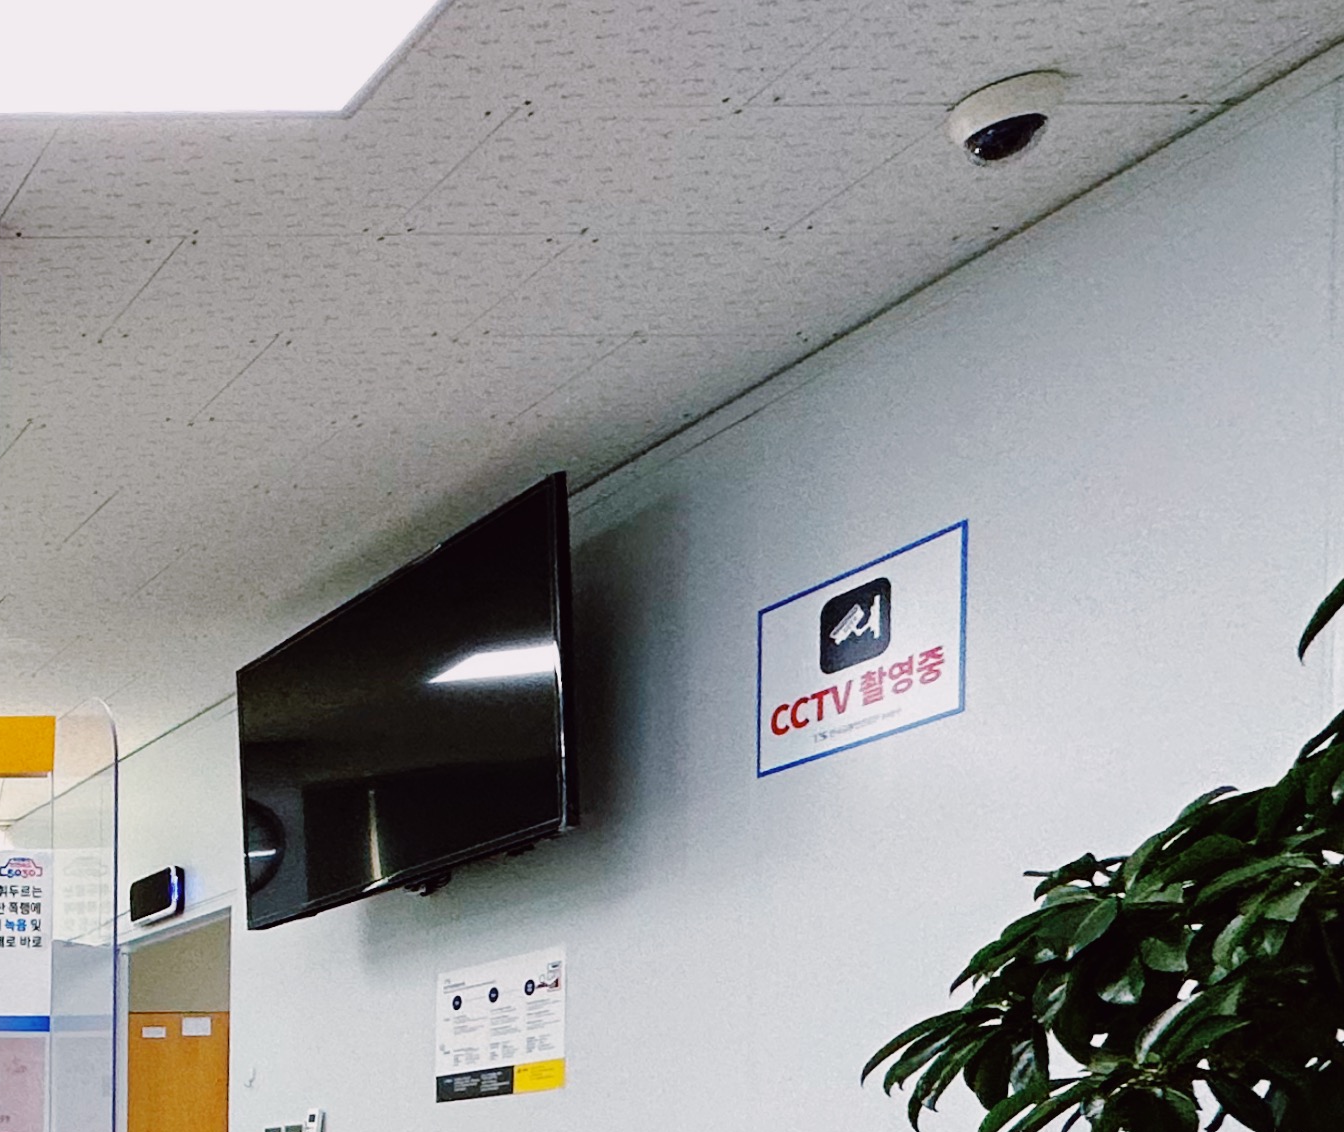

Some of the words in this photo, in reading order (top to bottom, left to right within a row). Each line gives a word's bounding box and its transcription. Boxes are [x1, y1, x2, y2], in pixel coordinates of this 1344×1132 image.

[770, 680, 853, 736] CCTV
[860, 646, 945, 707] 촬영중
[20, 934, 43, 947] 바로
